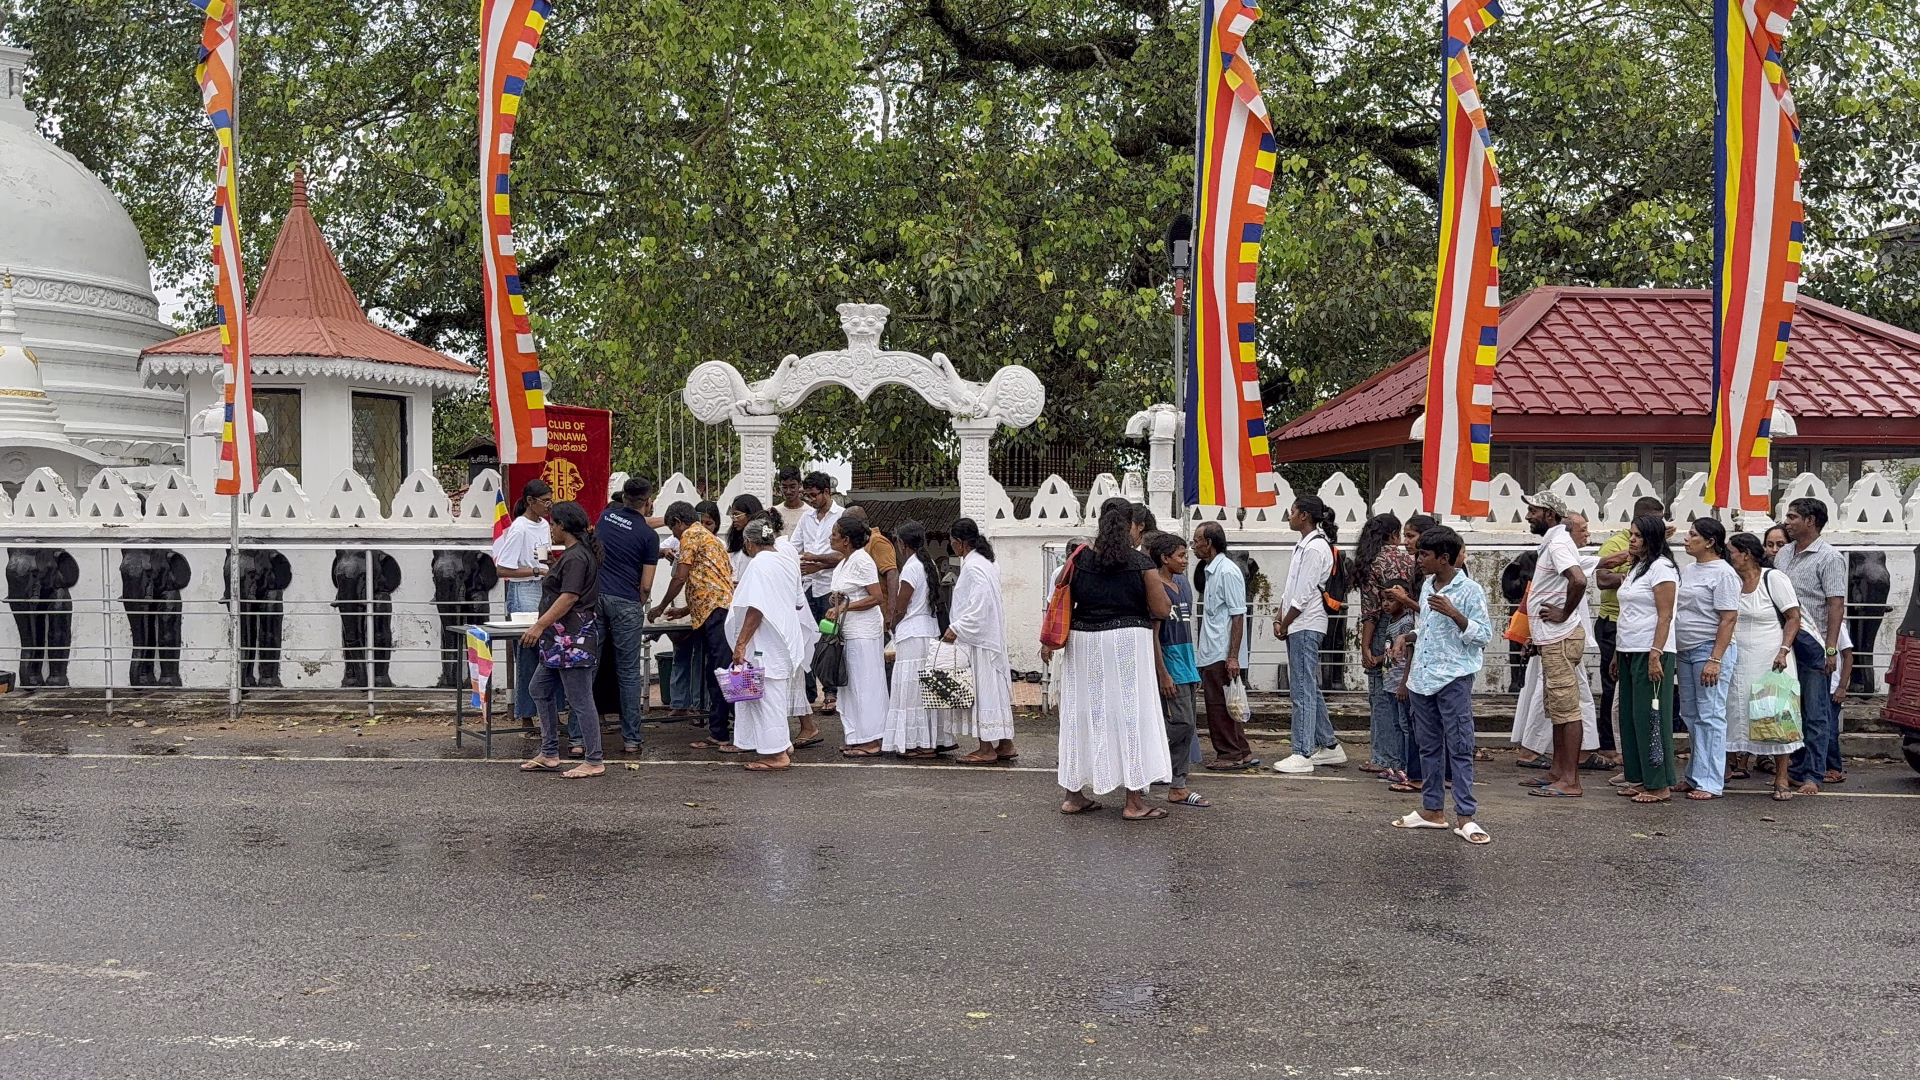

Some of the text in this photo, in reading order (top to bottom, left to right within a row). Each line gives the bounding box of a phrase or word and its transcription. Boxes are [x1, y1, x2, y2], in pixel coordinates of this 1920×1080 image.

[548, 420, 585, 431] CLUB OF
[557, 461, 565, 500] LEO
